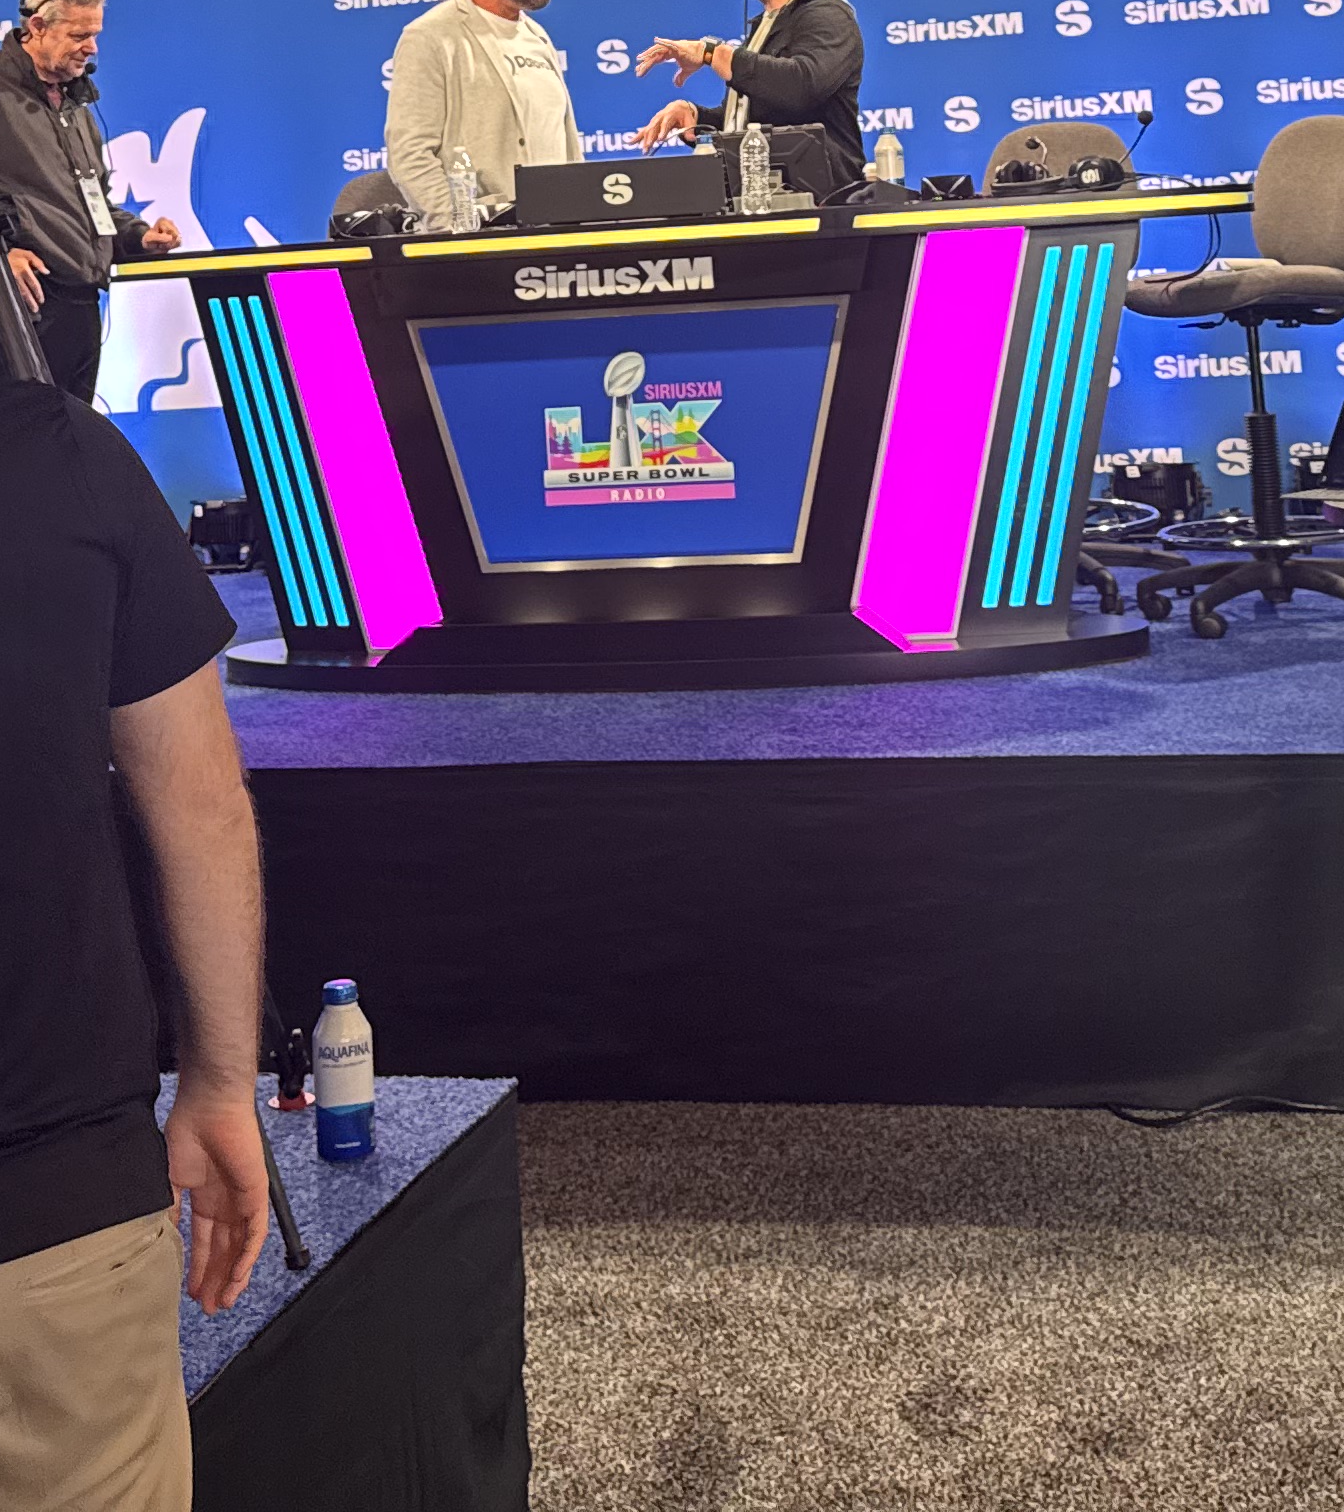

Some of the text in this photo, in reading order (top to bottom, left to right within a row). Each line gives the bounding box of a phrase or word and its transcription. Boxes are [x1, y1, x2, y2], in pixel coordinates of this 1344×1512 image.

[886, 11, 1023, 44] SiriusXM
[1012, 89, 1153, 122] SiriusXM
[514, 256, 714, 301] SiriusXM
[644, 380, 723, 401] SIRIUSXM
[568, 467, 710, 483] SUPER BOWL
[610, 487, 667, 502] RADIO
[318, 1041, 370, 1063] AQUAFINA
